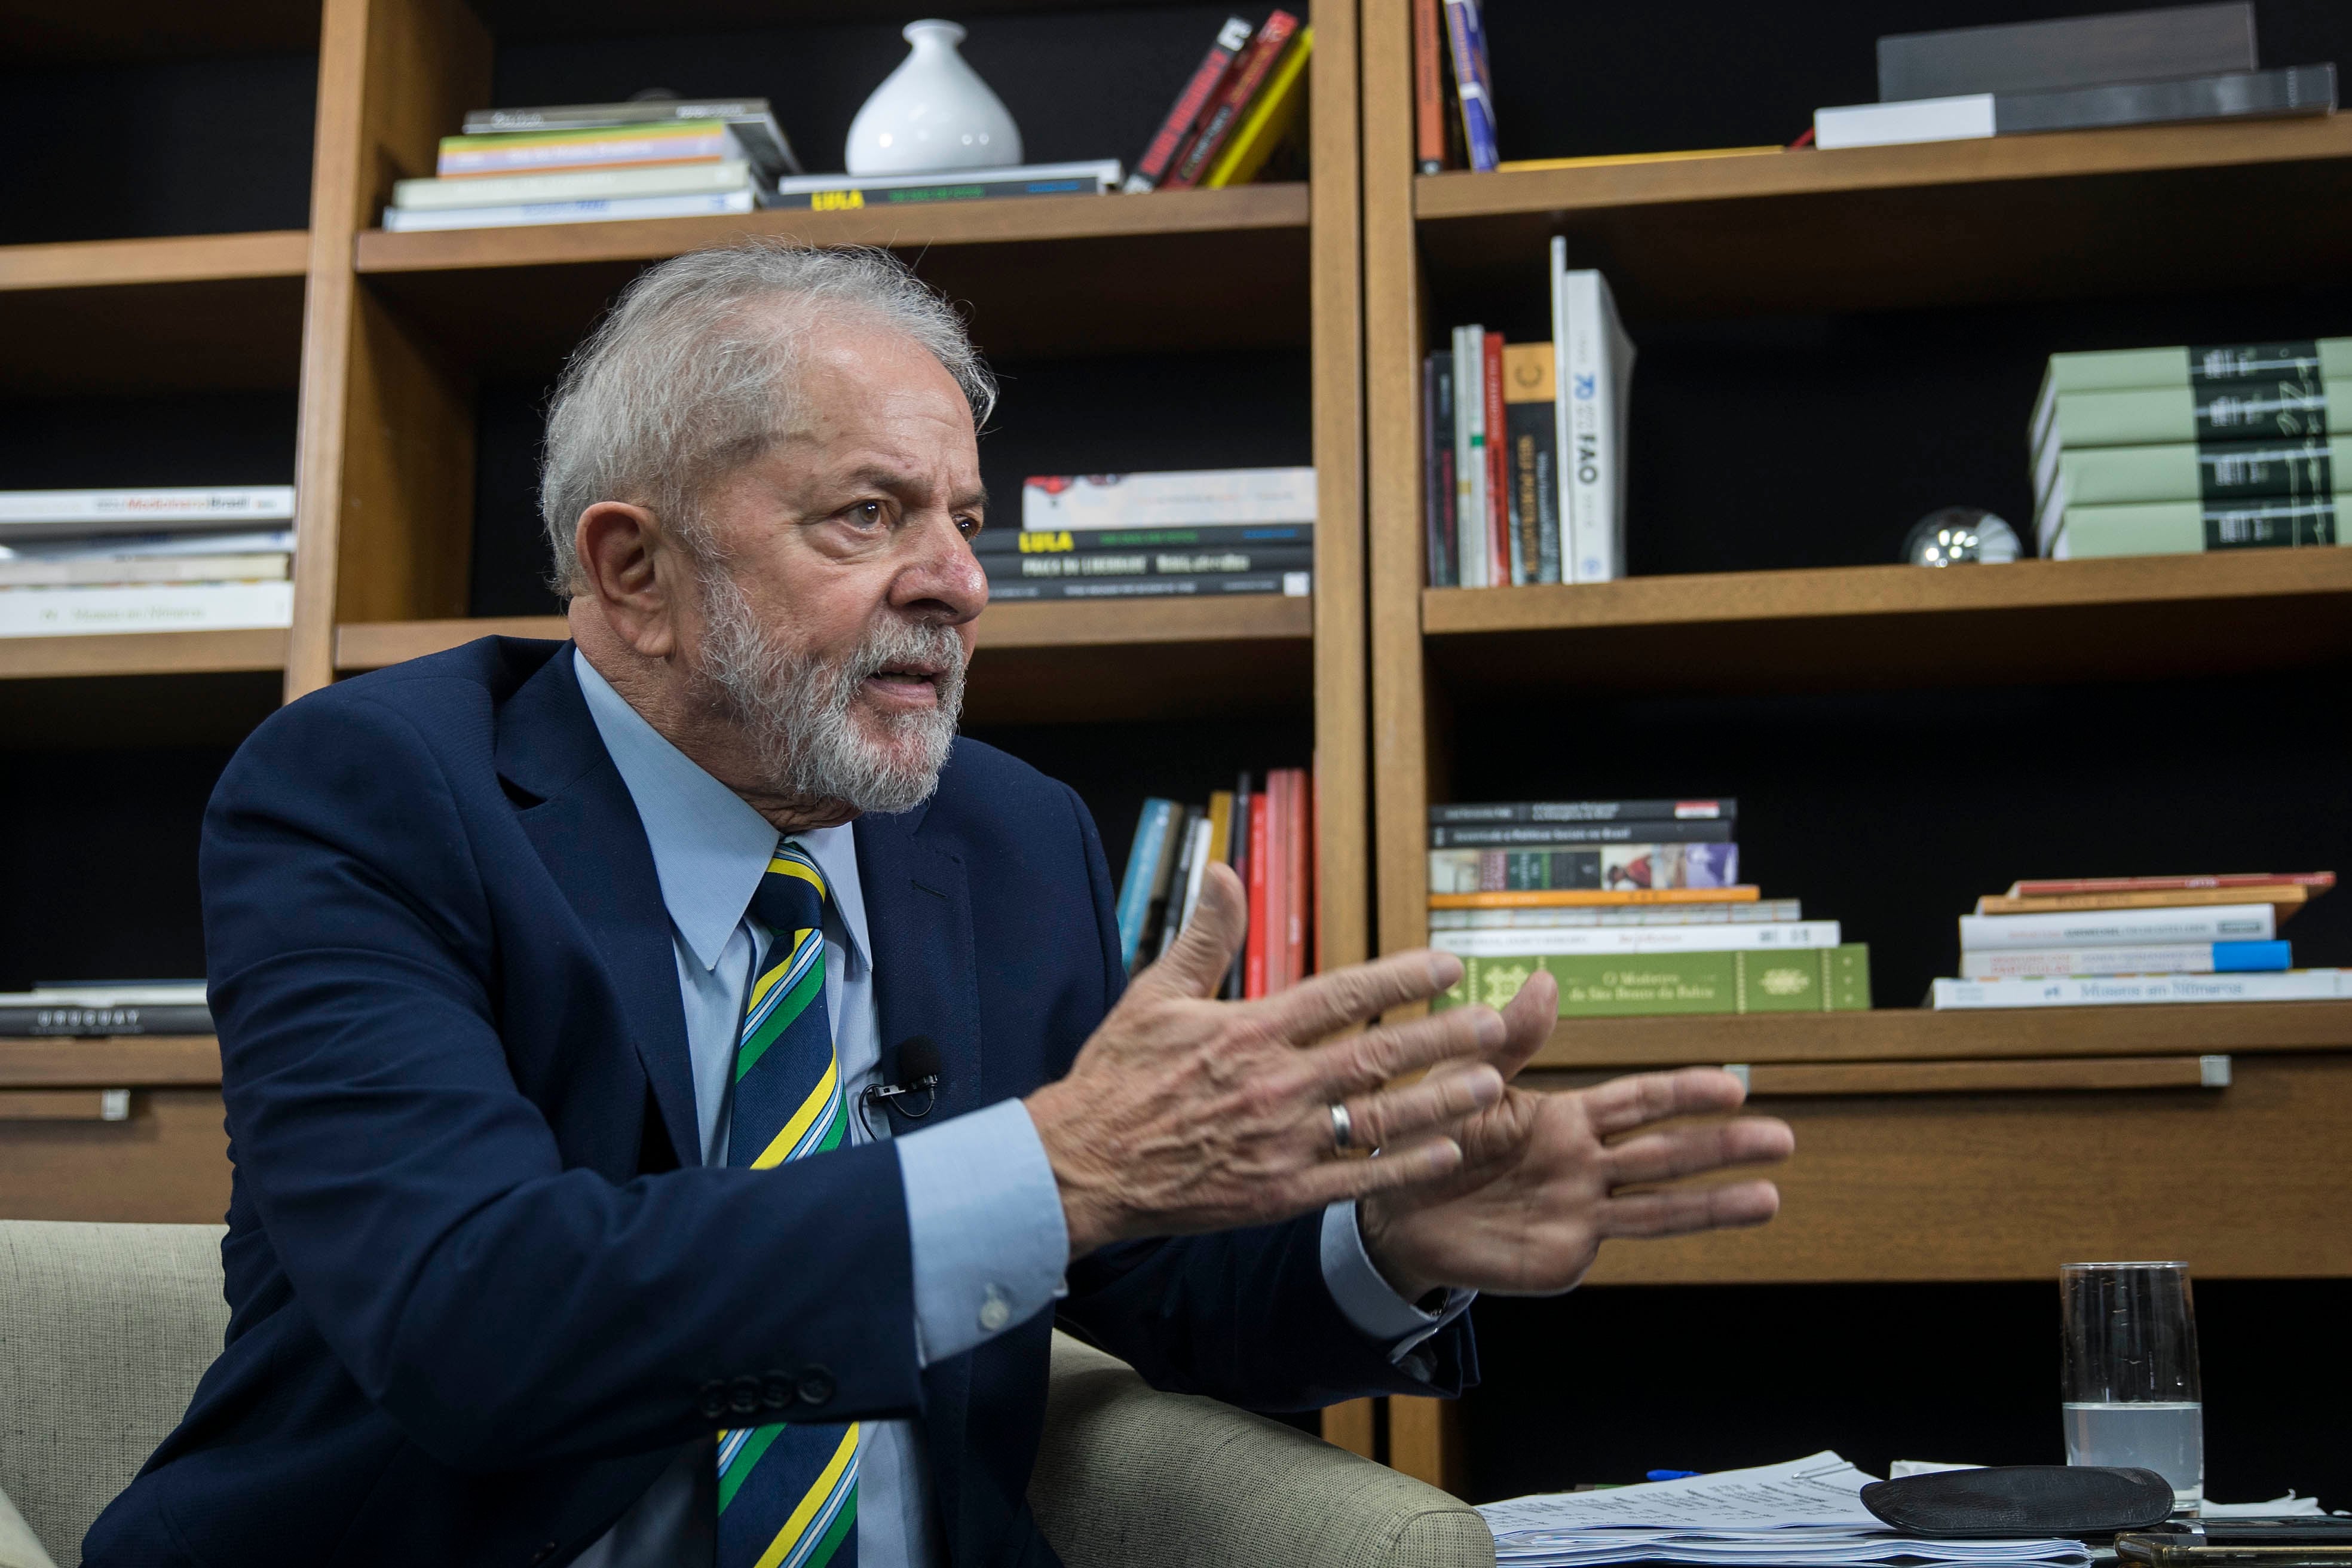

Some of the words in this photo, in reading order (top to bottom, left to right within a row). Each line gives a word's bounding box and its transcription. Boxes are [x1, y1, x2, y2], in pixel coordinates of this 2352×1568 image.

[811, 189, 865, 212] LULA
[1575, 373, 1595, 400] 70
[1578, 433, 1598, 485] FAO
[1019, 531, 1074, 553] LULA
[1602, 971, 1618, 987] O
[1656, 986, 1673, 1000] da
[1676, 984, 1715, 999] Bahia
